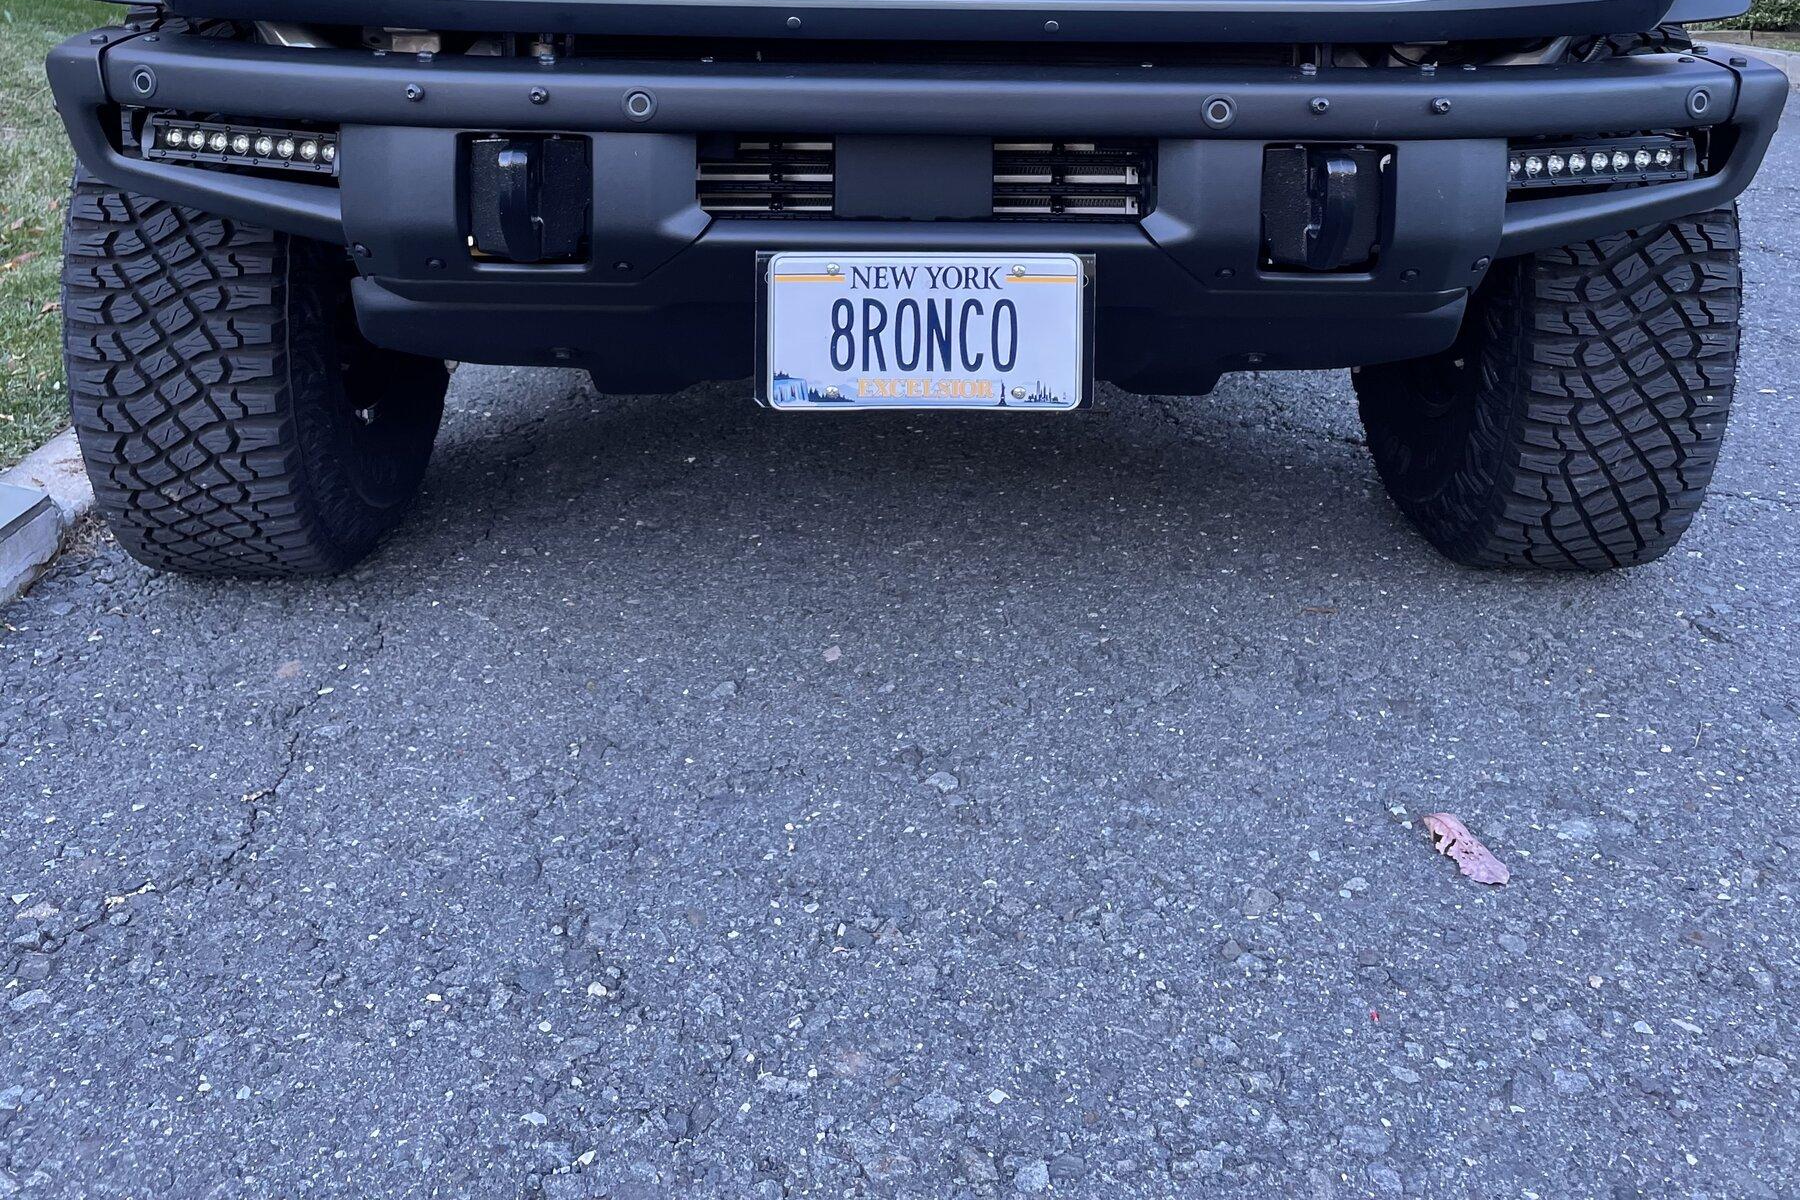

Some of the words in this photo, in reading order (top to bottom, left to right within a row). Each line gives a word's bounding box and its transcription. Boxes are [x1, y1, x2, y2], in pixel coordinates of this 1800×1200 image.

[850, 266, 918, 290] NEW
[925, 266, 1003, 290] YORK
[830, 298, 1018, 373] 8RONCO
[857, 378, 994, 399] EXCELSIOR
